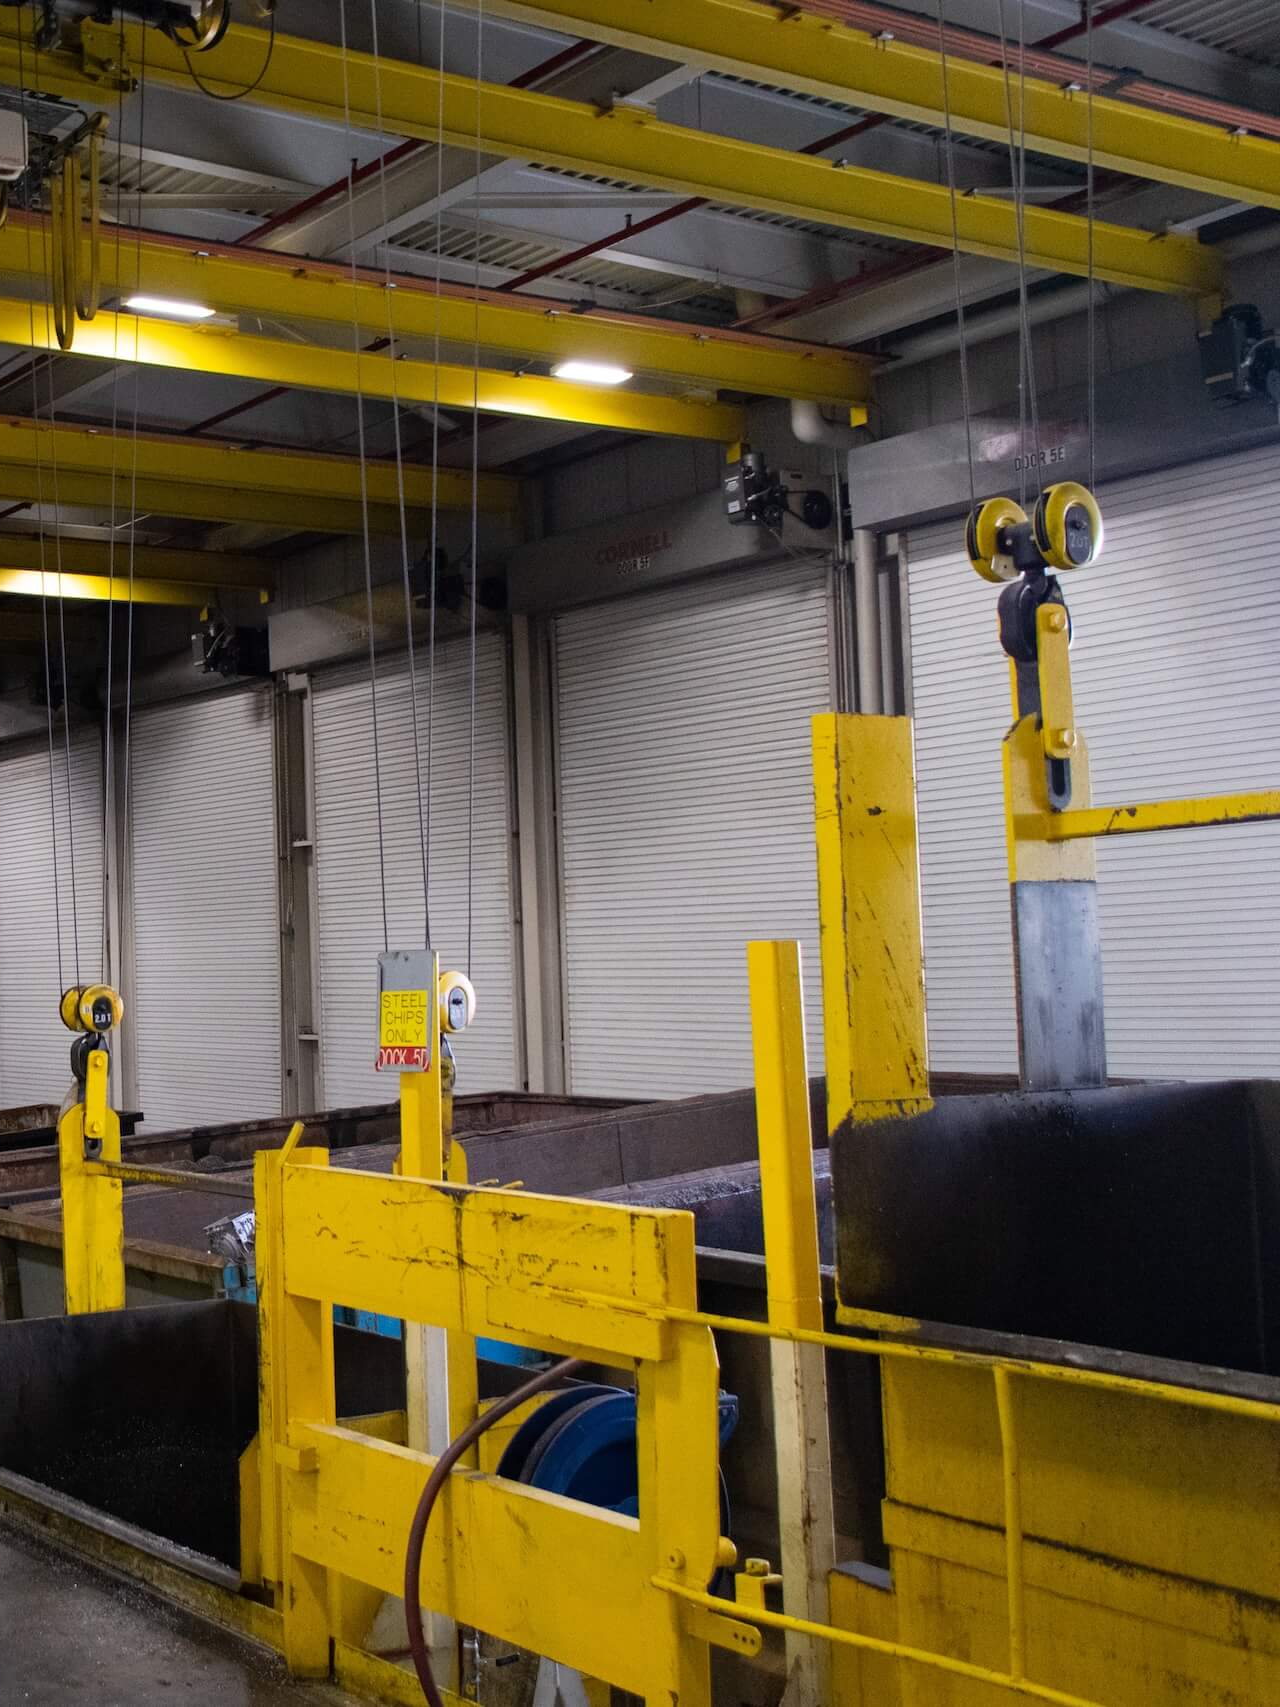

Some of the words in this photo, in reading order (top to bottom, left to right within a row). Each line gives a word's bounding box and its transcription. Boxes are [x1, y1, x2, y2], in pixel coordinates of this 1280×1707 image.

[1015, 452, 1046, 472] DOOR
[1050, 447, 1065, 462] 5E
[382, 993, 427, 1009] STEEL
[385, 1010, 424, 1025] CHIPS
[385, 1029, 422, 1043] ONLY
[376, 1048, 408, 1070] DOCK
